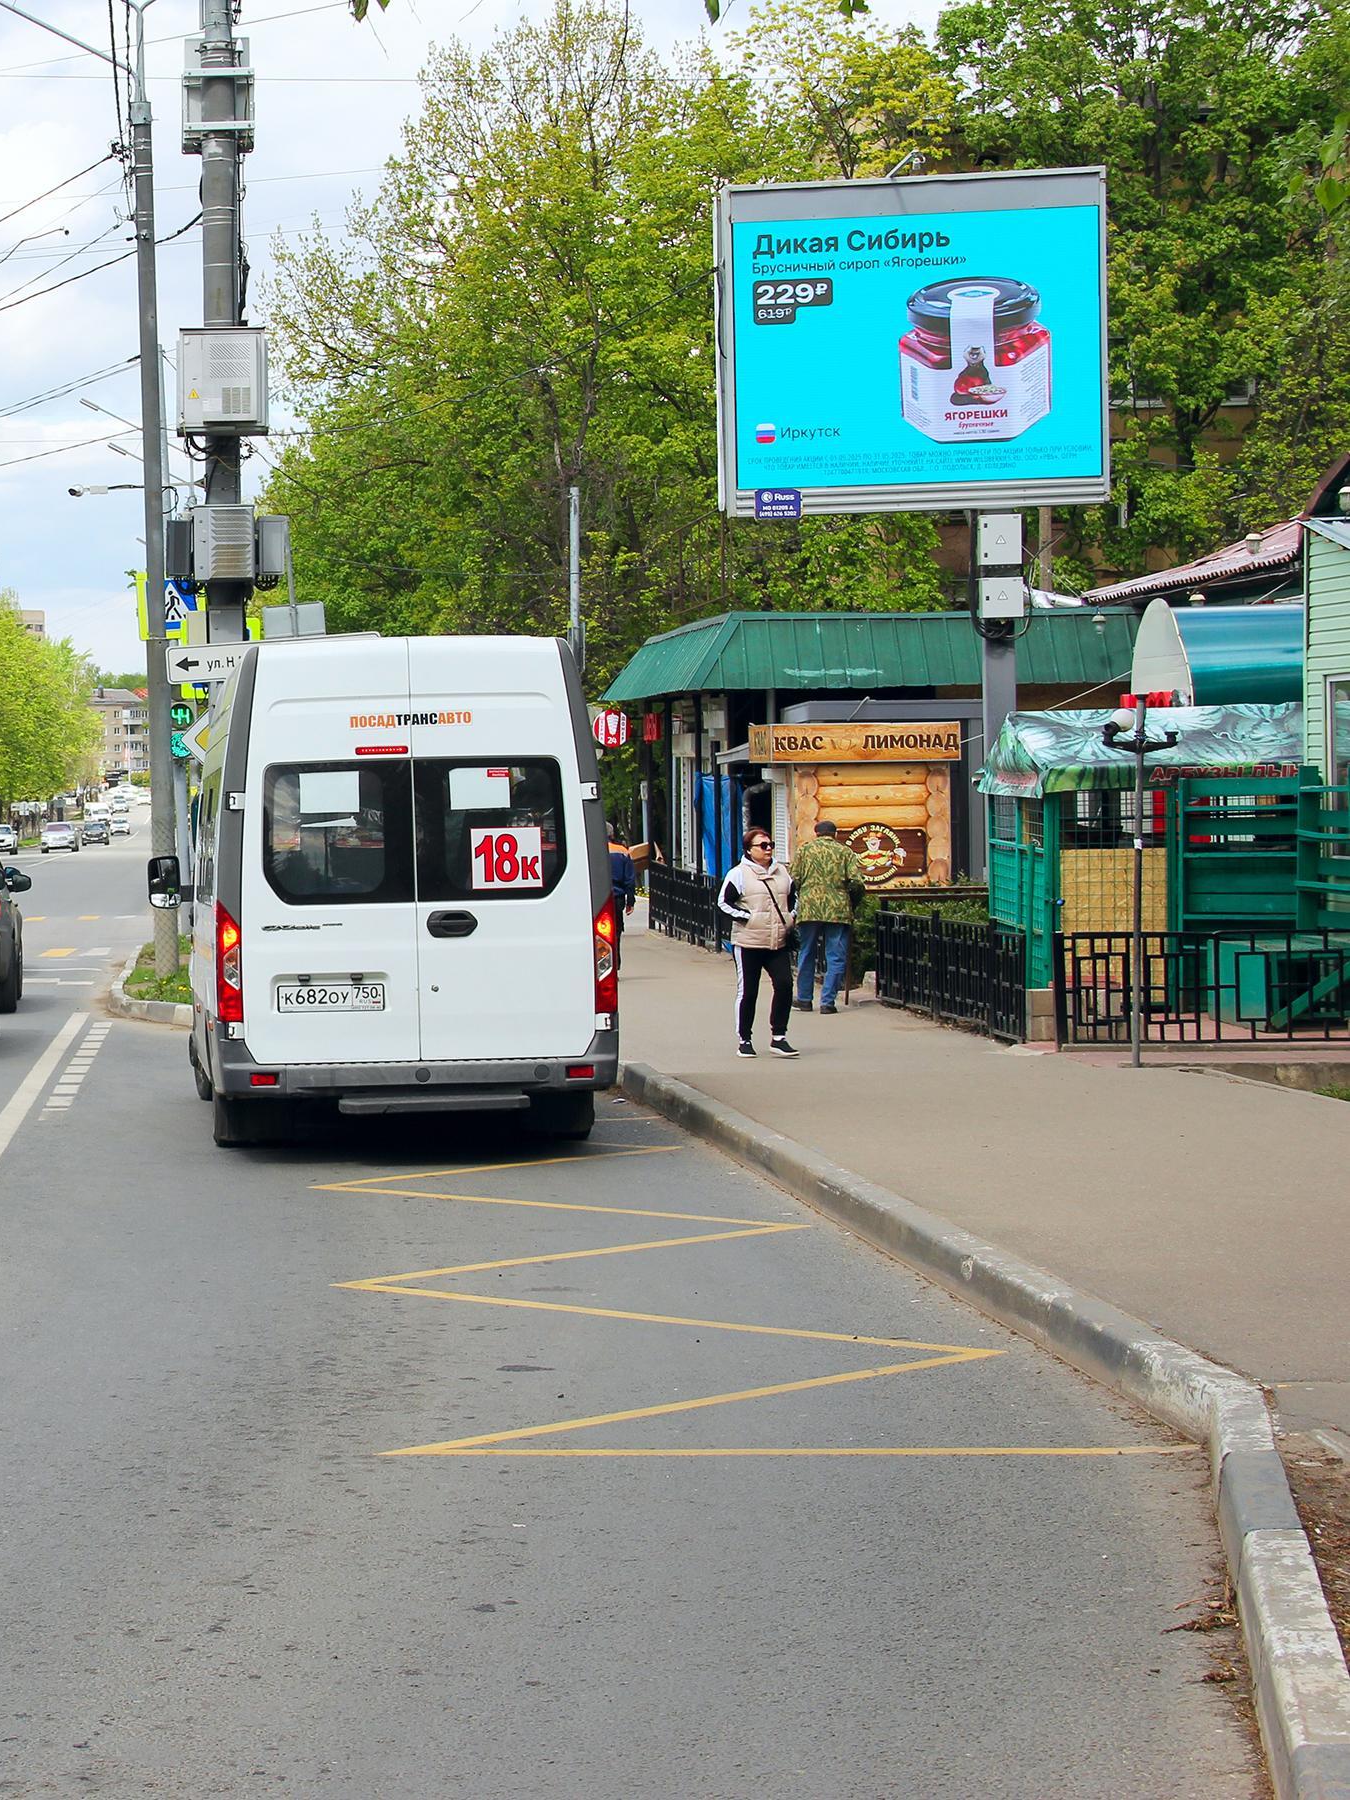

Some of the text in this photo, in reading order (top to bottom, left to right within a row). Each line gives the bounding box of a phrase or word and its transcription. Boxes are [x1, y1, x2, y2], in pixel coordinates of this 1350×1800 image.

[752, 228, 950, 259] Дикая Сибирь
[752, 255, 967, 276] Брусничный сироп «Ягорешки»
[944, 409, 1008, 421] ЯГОРЕШКИ
[780, 427, 841, 442] Иркутск
[774, 493, 795, 501] Russ
[207, 659, 225, 672] ул.
[350, 711, 472, 728] ПОСАДТРАНСАВТО
[774, 734, 959, 751] КВАС ЛИМОНАД
[1149, 764, 1299, 783] АРБУЗЫ ДЫН
[284, 986, 379, 1006] К682ОУ 750
